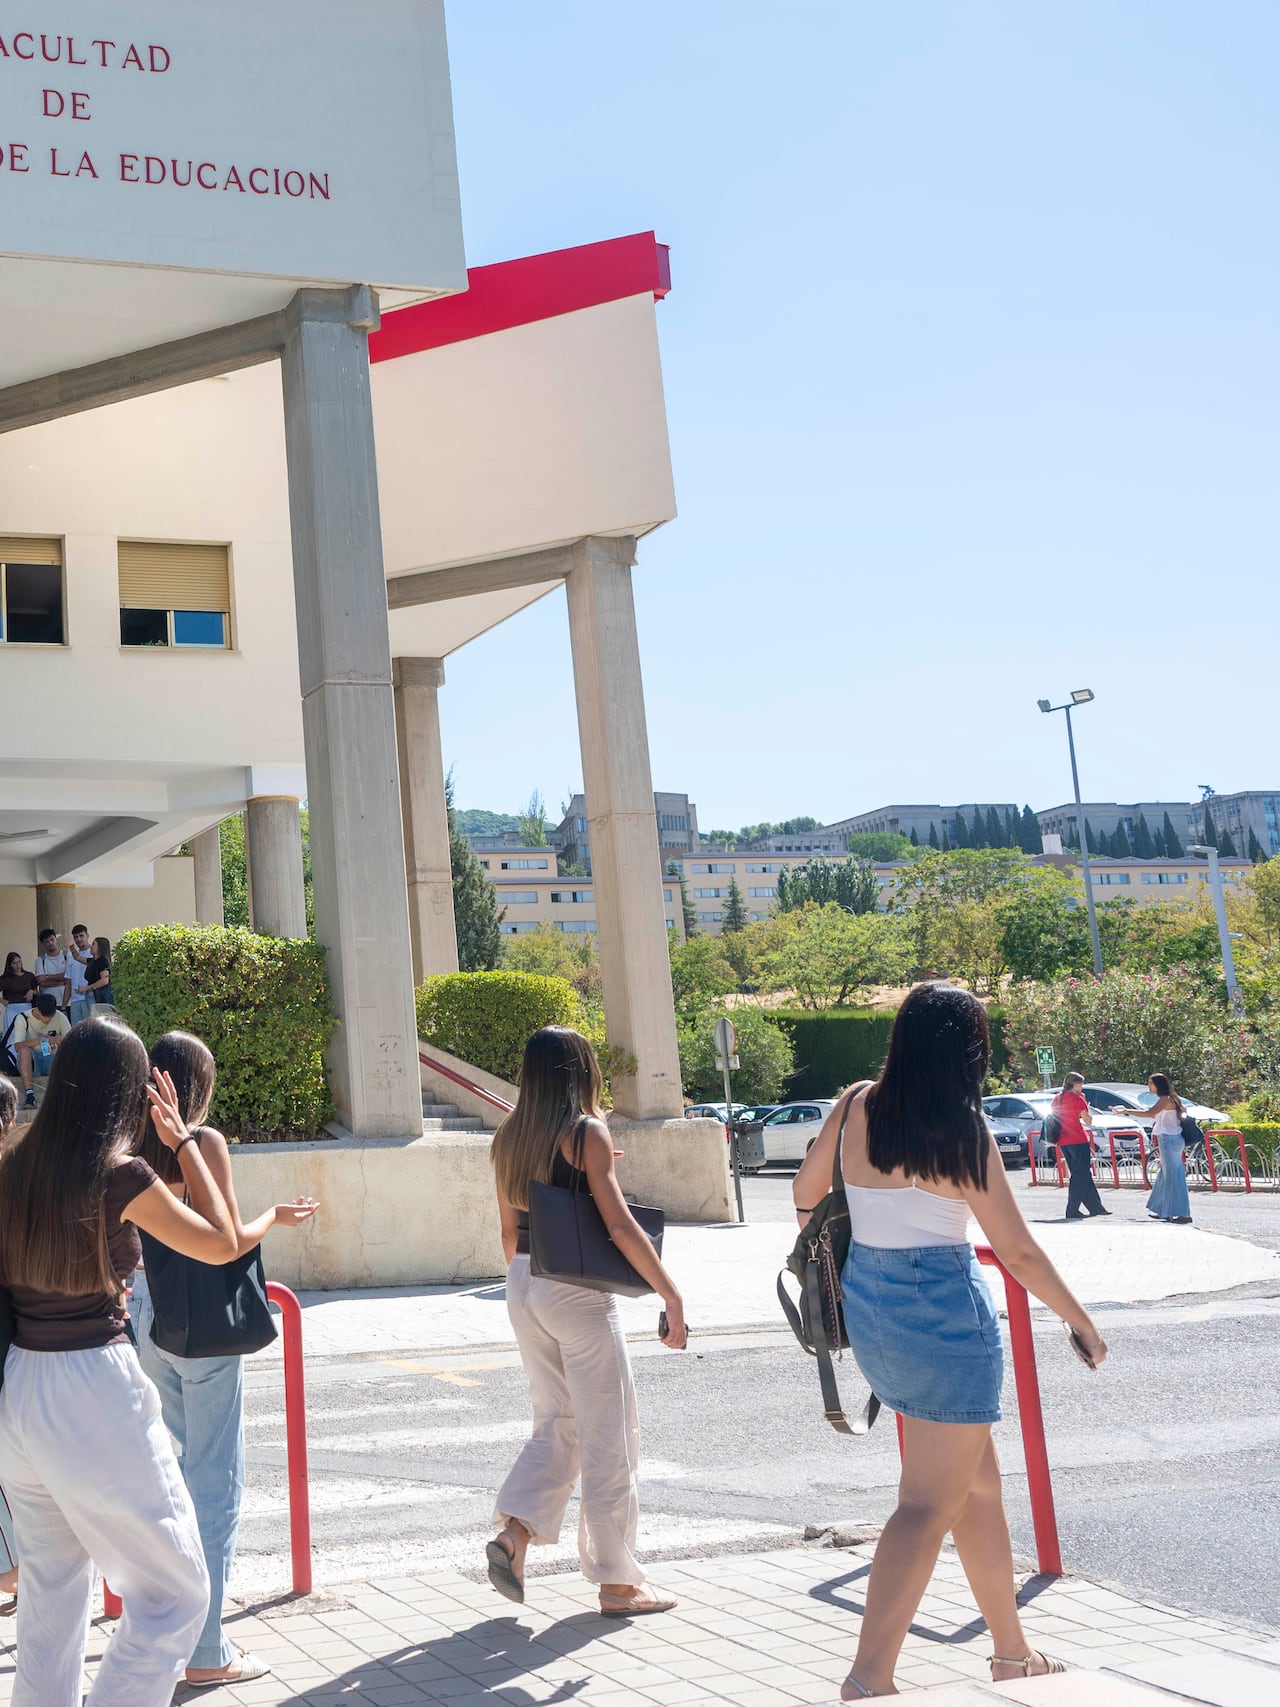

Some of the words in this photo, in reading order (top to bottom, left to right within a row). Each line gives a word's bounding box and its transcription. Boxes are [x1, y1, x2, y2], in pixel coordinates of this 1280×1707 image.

[42, 88, 91, 121] DE
[50, 147, 99, 179] LA
[119, 153, 330, 201] EDUCACION
